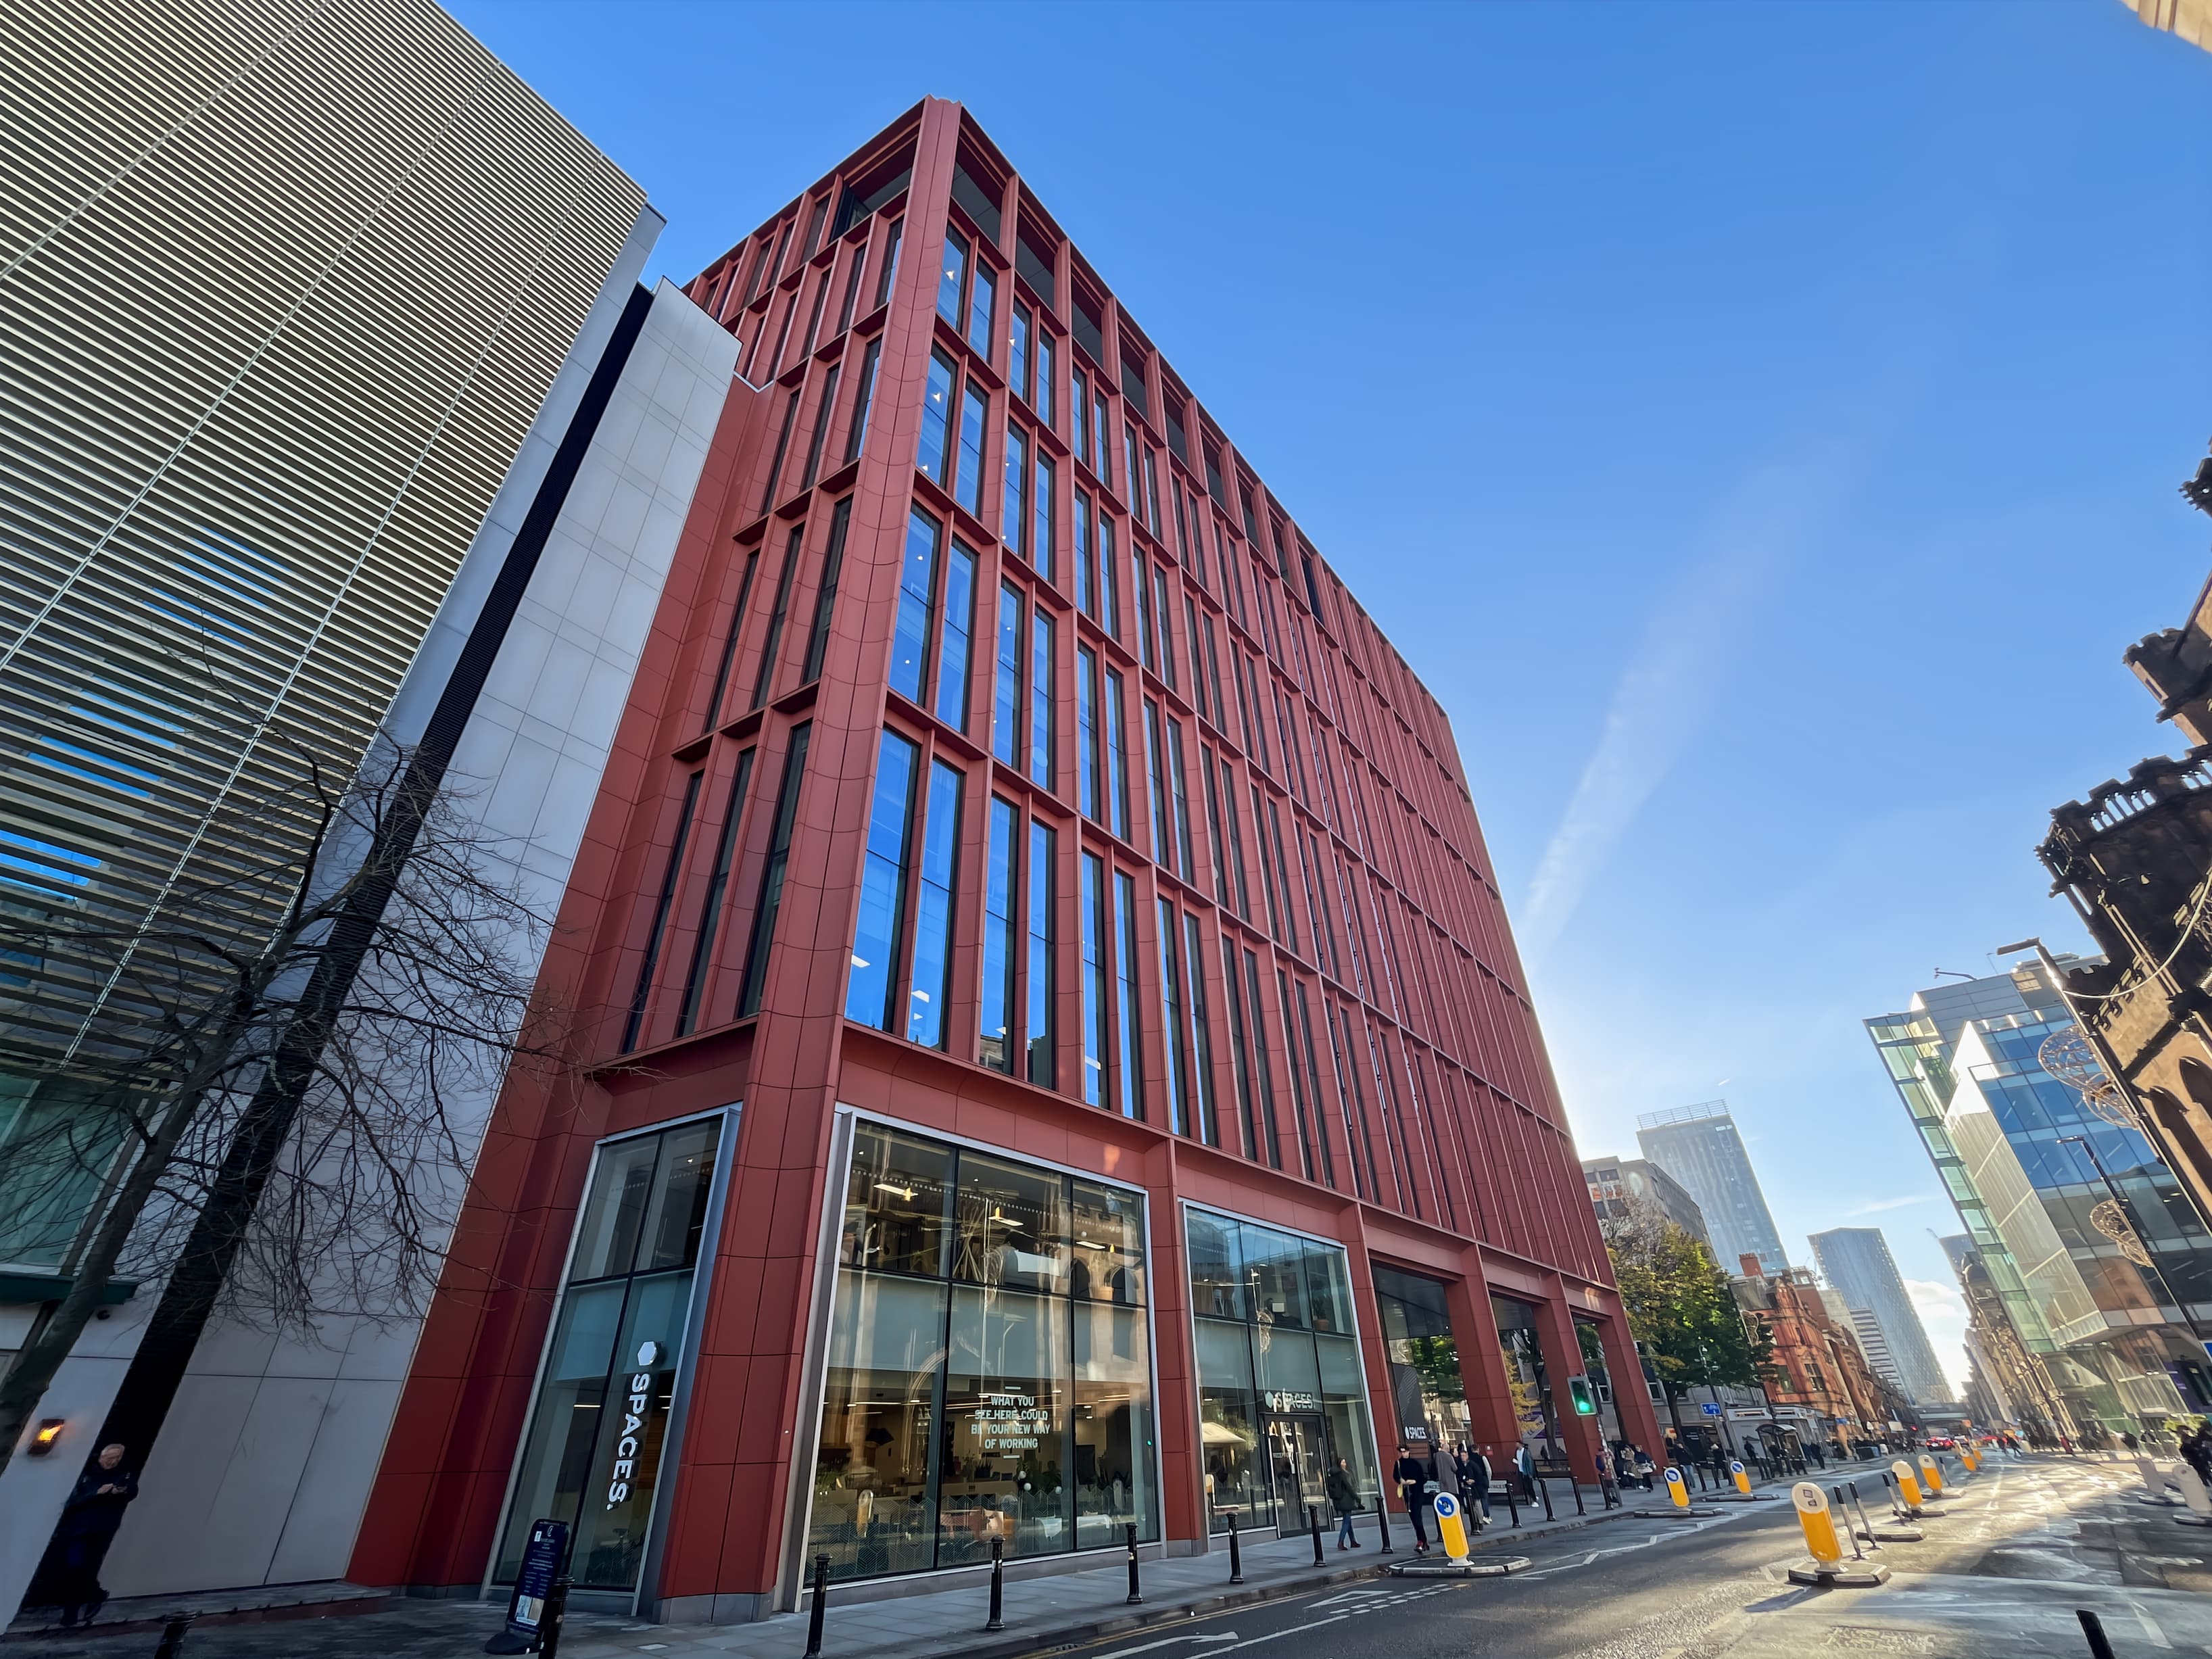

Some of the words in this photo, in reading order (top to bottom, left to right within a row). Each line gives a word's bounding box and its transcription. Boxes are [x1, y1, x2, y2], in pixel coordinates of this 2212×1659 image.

[990, 1396, 1015, 1406] WHAT
[1017, 1396, 1034, 1406] YOU
[974, 1410, 992, 1420] SEE
[1021, 1410, 1049, 1420] COULD
[986, 1424, 1010, 1434] YOUR
[1012, 1424, 1031, 1434] NEW
[1032, 1424, 1051, 1434] WAY
[984, 1439, 997, 1449] OF
[999, 1439, 1038, 1449] WORKING
